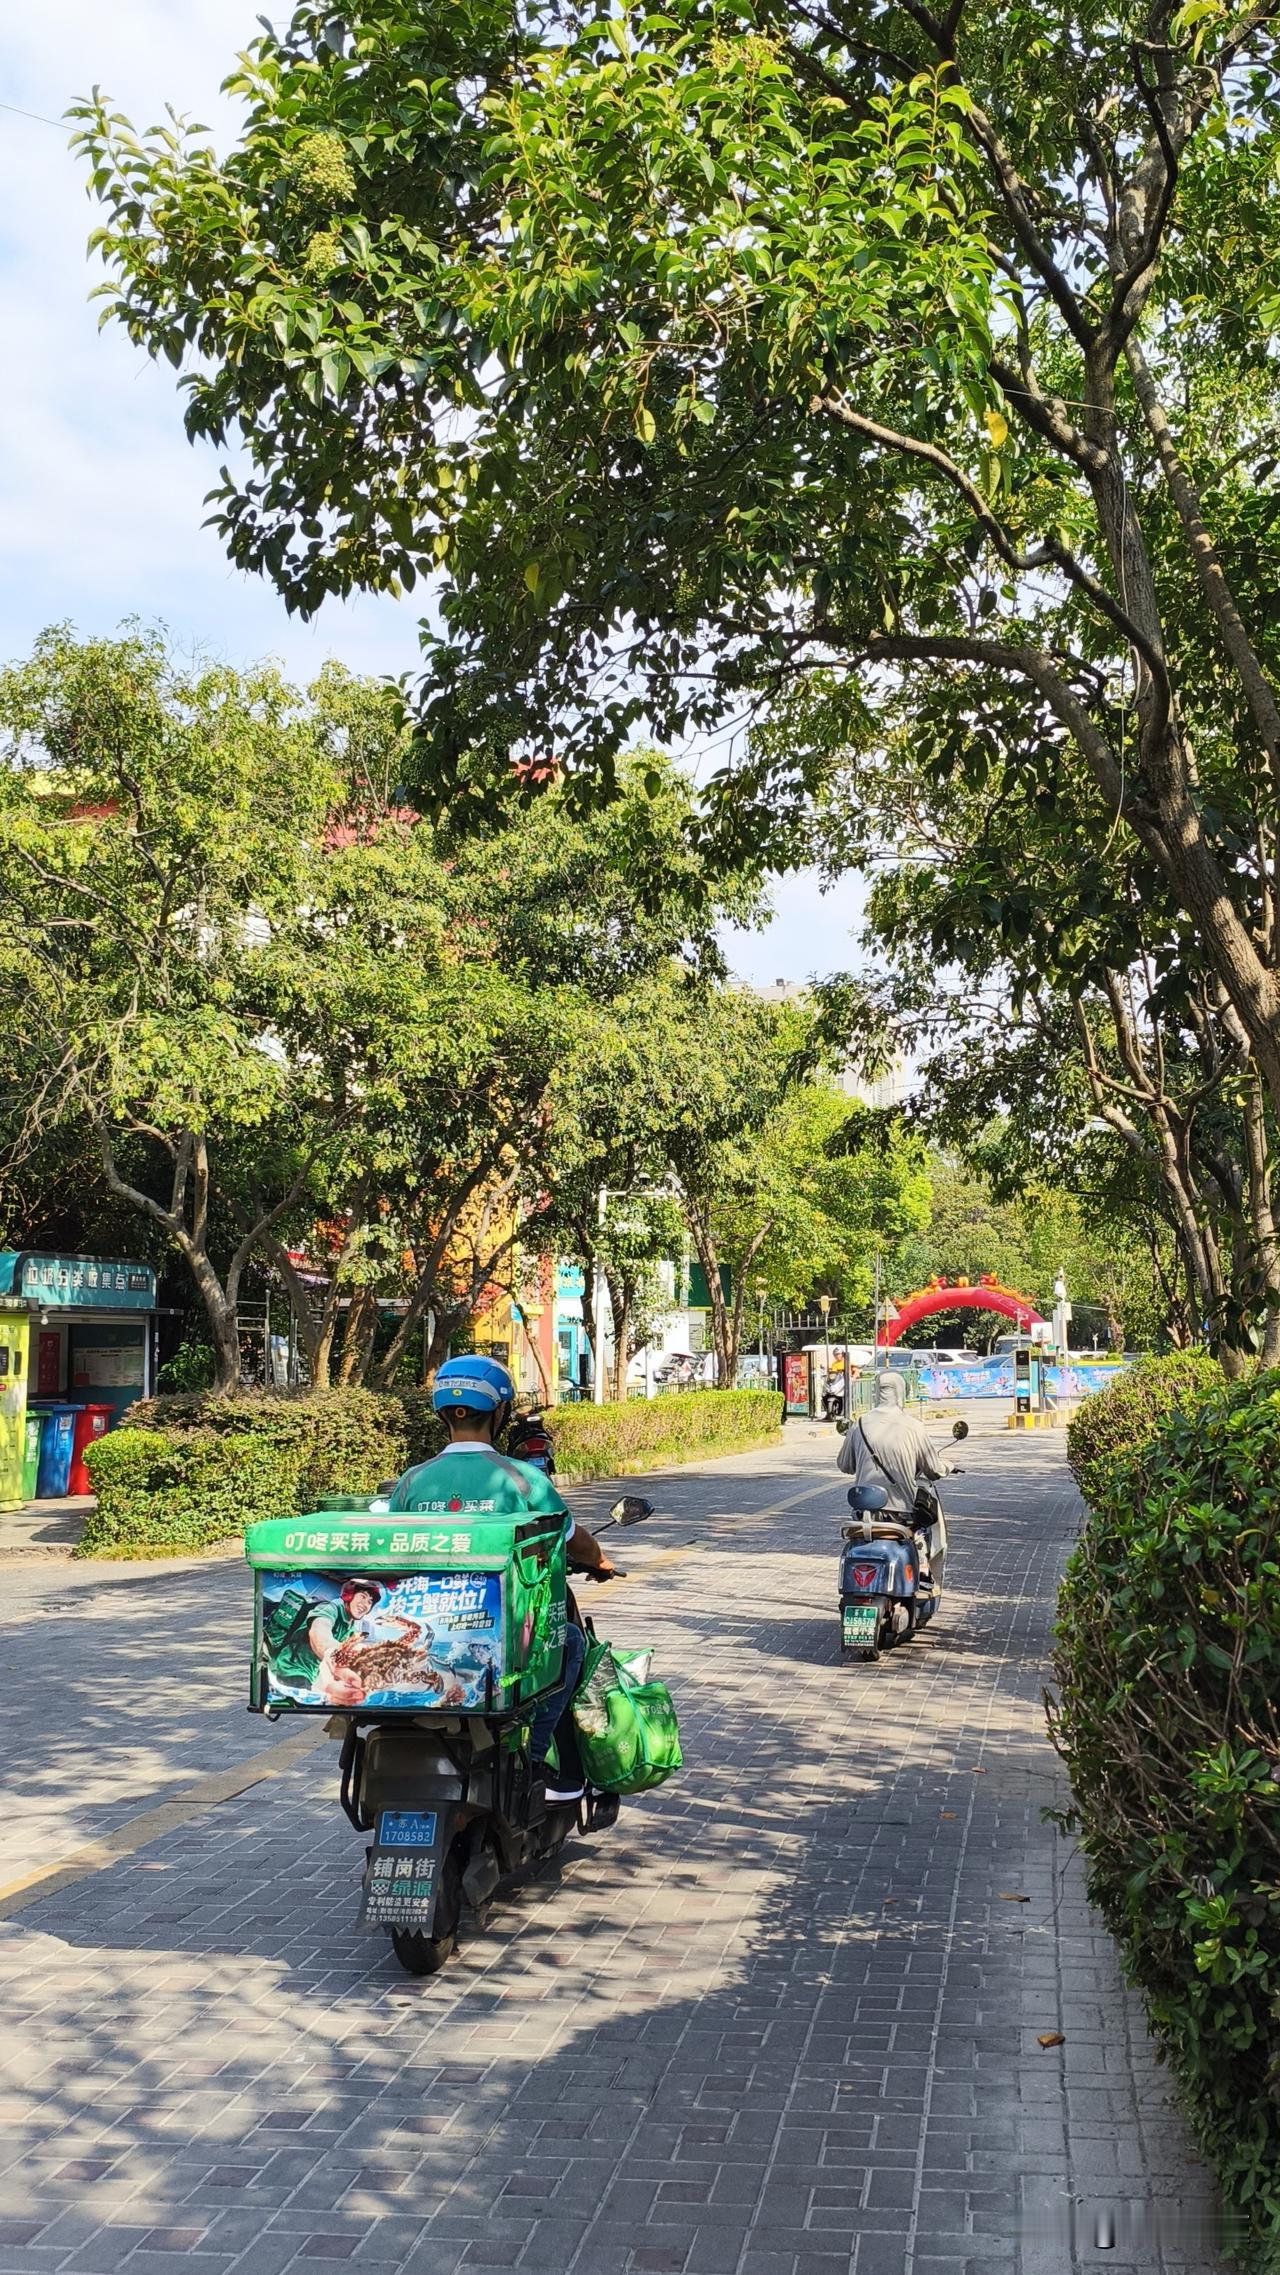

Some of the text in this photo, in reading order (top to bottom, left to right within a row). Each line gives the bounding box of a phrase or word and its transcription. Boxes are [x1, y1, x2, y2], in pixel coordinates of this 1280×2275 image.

[26, 1265, 125, 1290] 垃圾分类收集点
[417, 1499, 495, 1513] 叮咚 买菜
[285, 1531, 472, 1553] 叮咚买菜 品质之爱
[385, 1831, 431, 1842] 1708582
[374, 1857, 436, 1879] 铺岗街
[391, 1880, 432, 1896] 绿源
